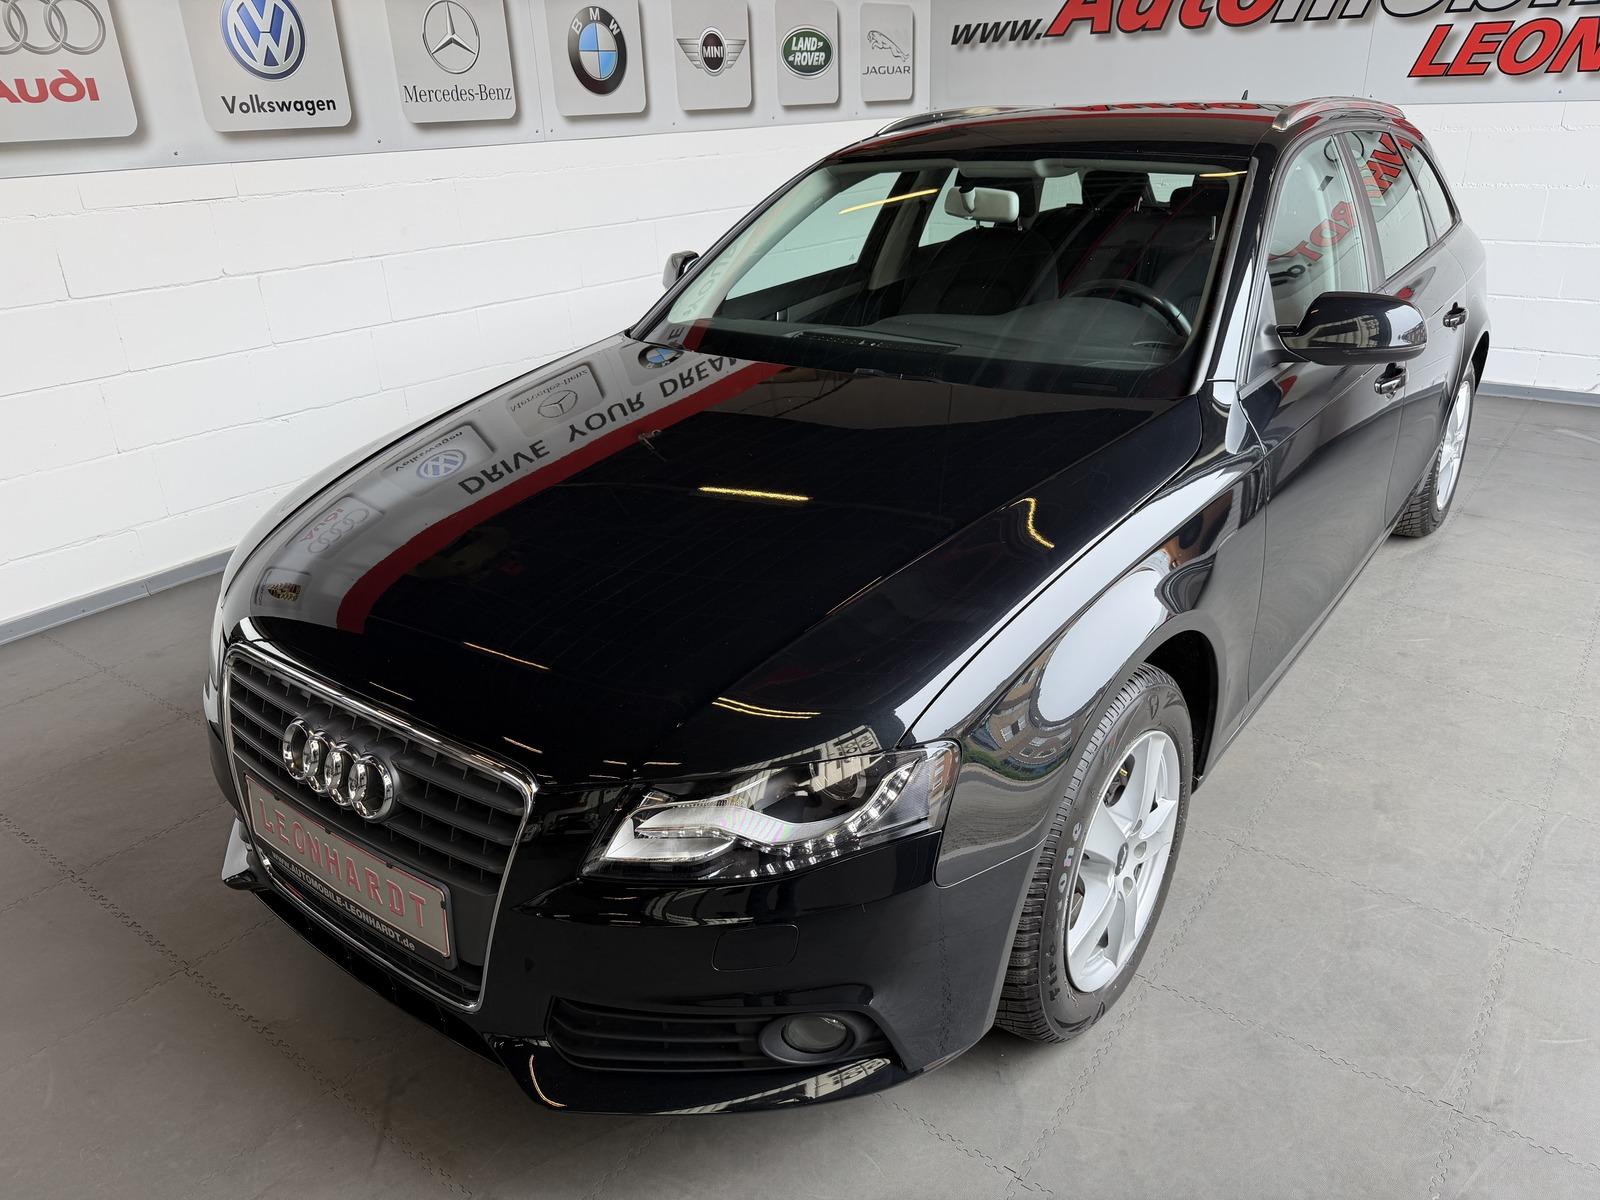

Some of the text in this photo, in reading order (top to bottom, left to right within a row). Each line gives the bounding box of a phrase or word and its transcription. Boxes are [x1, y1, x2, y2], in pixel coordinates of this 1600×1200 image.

[572, 7, 621, 36] BMW
[702, 45, 724, 58] MINI
[791, 37, 818, 51] LAND
[793, 52, 826, 66] ROVER
[862, 65, 911, 75] JAGUAR
[403, 83, 512, 104] Mercedes-Benz
[221, 94, 337, 116] Volkswagen
[259, 798, 426, 928] LEONHARDT
[272, 851, 416, 951] www.AUTOMOBILE-LEONHARDT.de
